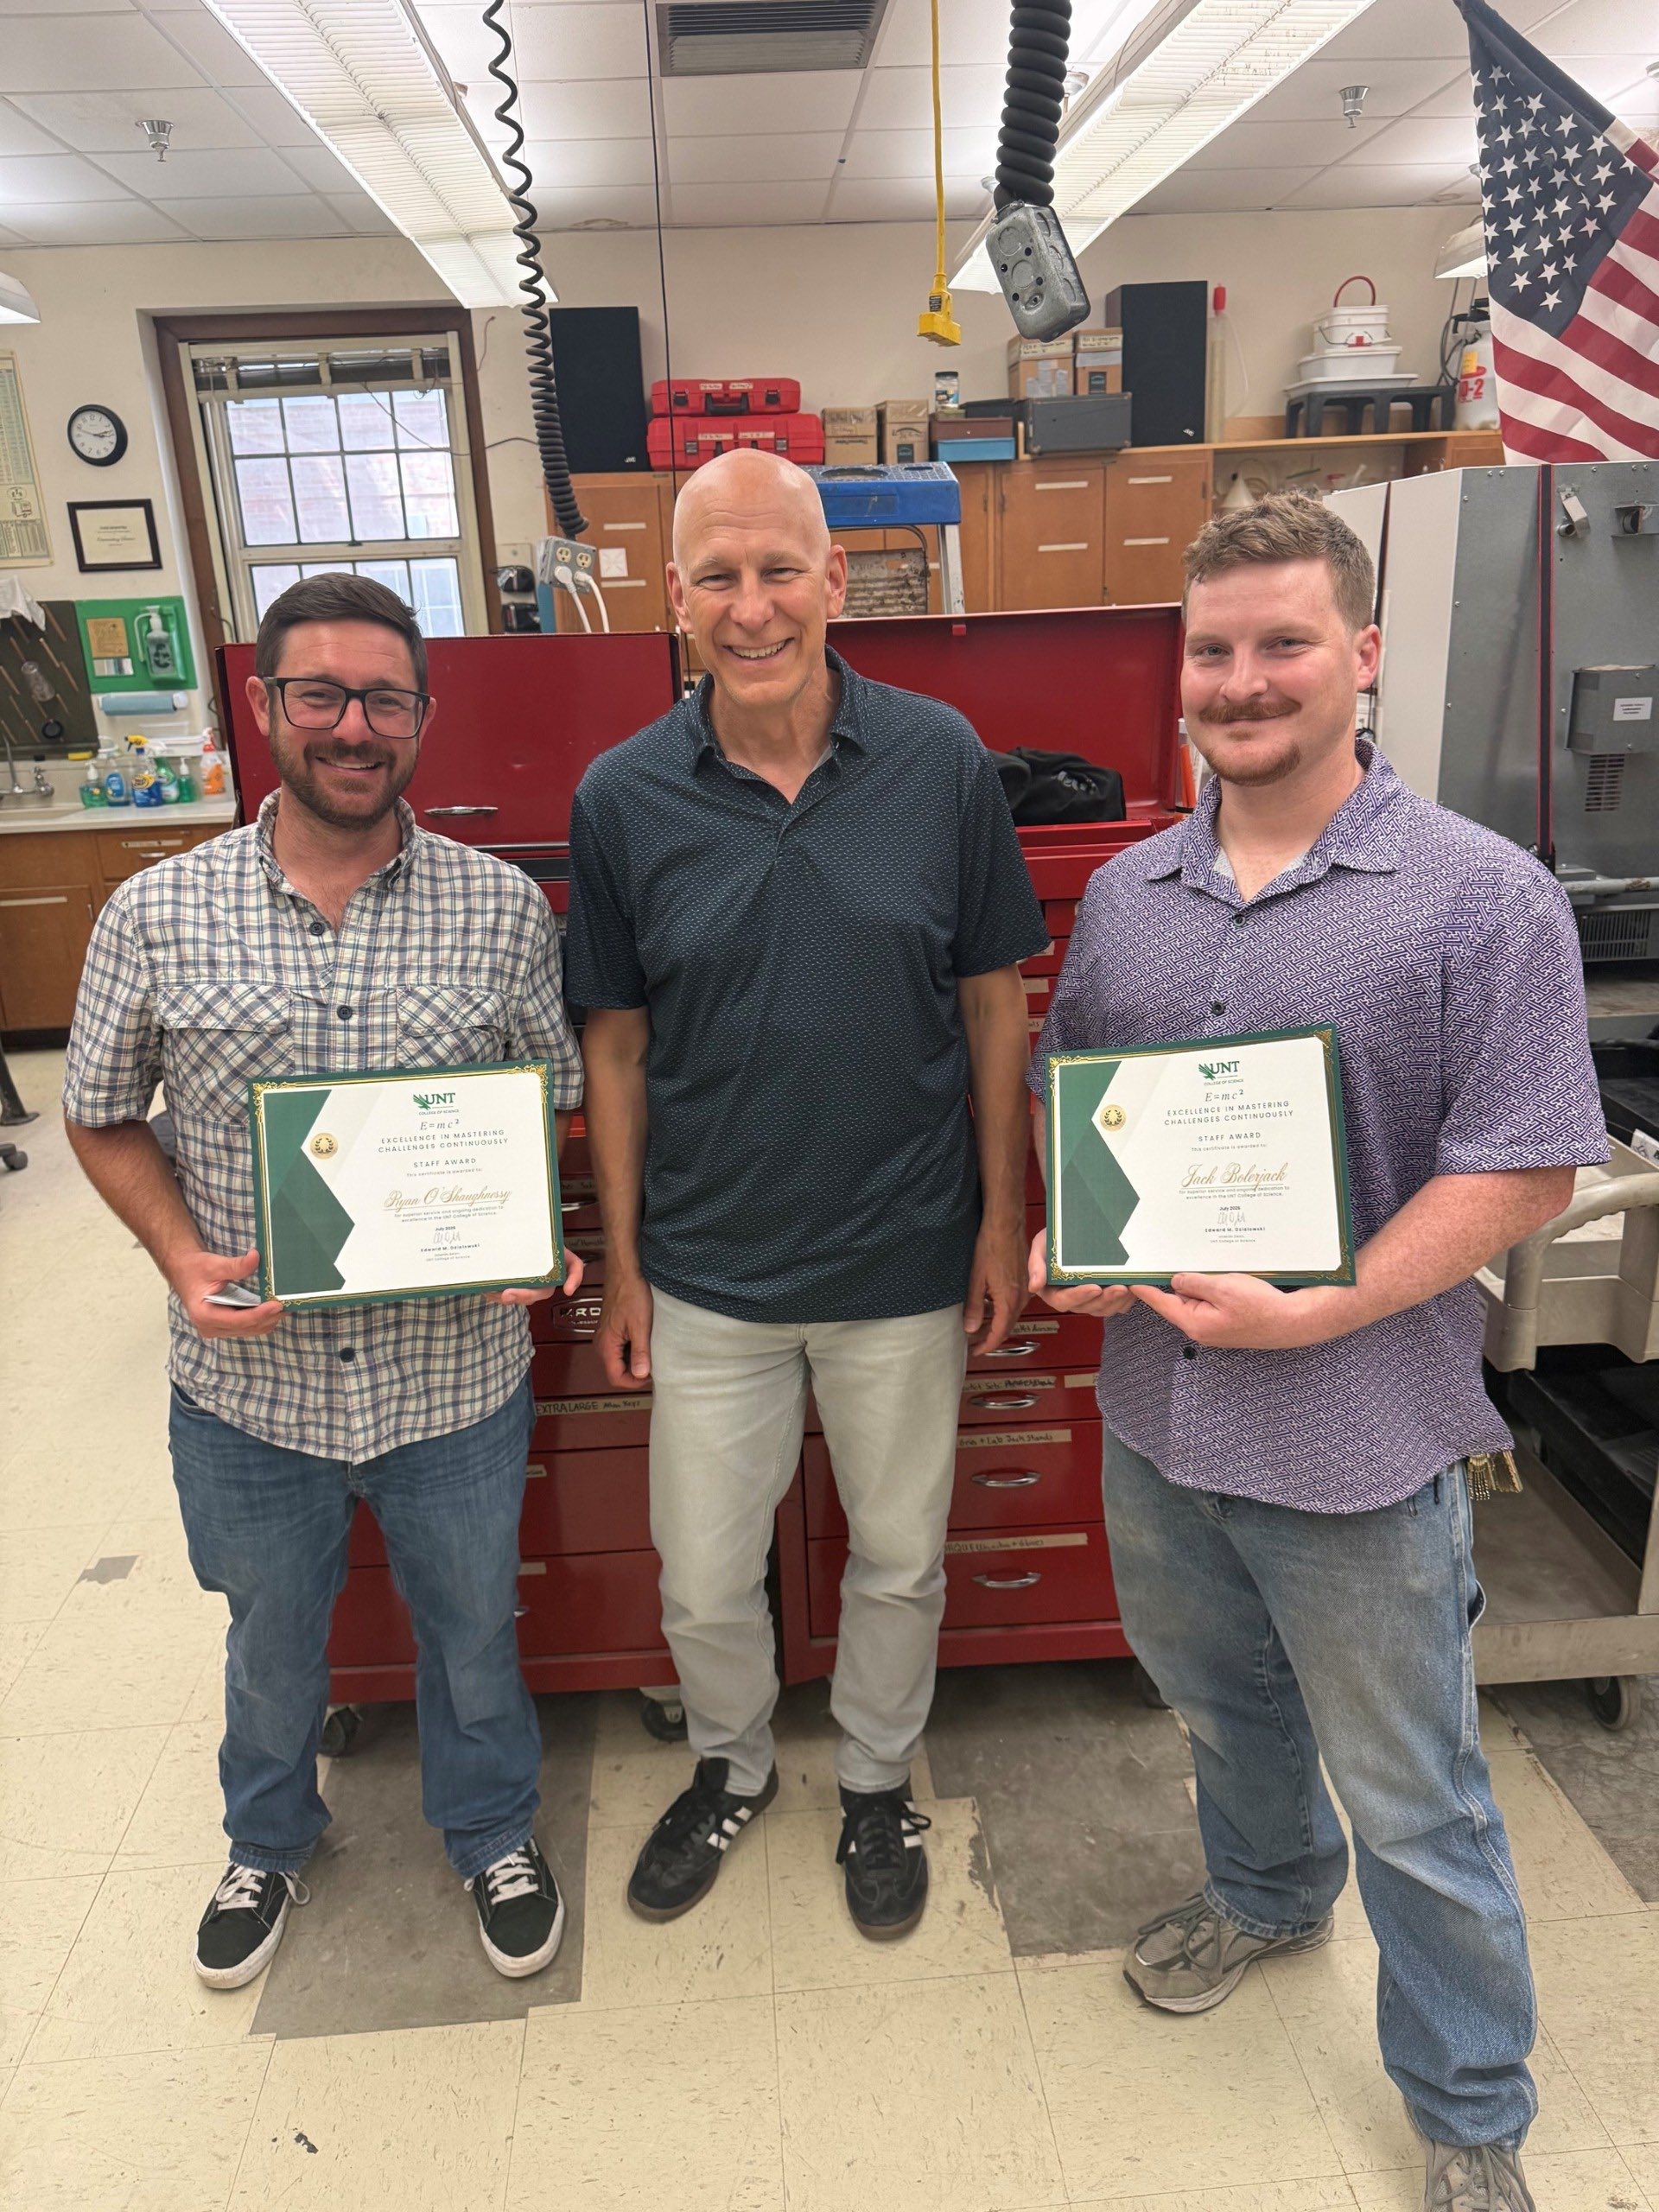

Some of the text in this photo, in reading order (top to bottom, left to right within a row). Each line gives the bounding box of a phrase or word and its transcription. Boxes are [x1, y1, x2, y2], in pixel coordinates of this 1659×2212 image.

[1210, 1061, 1240, 1074] UNT
[425, 1092, 455, 1105] UNT
[1167, 1107, 1221, 1116] EXCELLENCE
[1238, 1101, 1289, 1110] MASTERING
[1164, 1110, 1294, 1125] CHALLENGES CONTINUOUSLY
[381, 1135, 436, 1144] EXCELLENCE
[454, 1129, 505, 1138] MASTERING
[378, 1138, 508, 1153] CHALLENGES CONTINUOUSLY
[1181, 1162, 1288, 1192] Jack Bolerjack
[384, 1190, 419, 1213] Ryan
